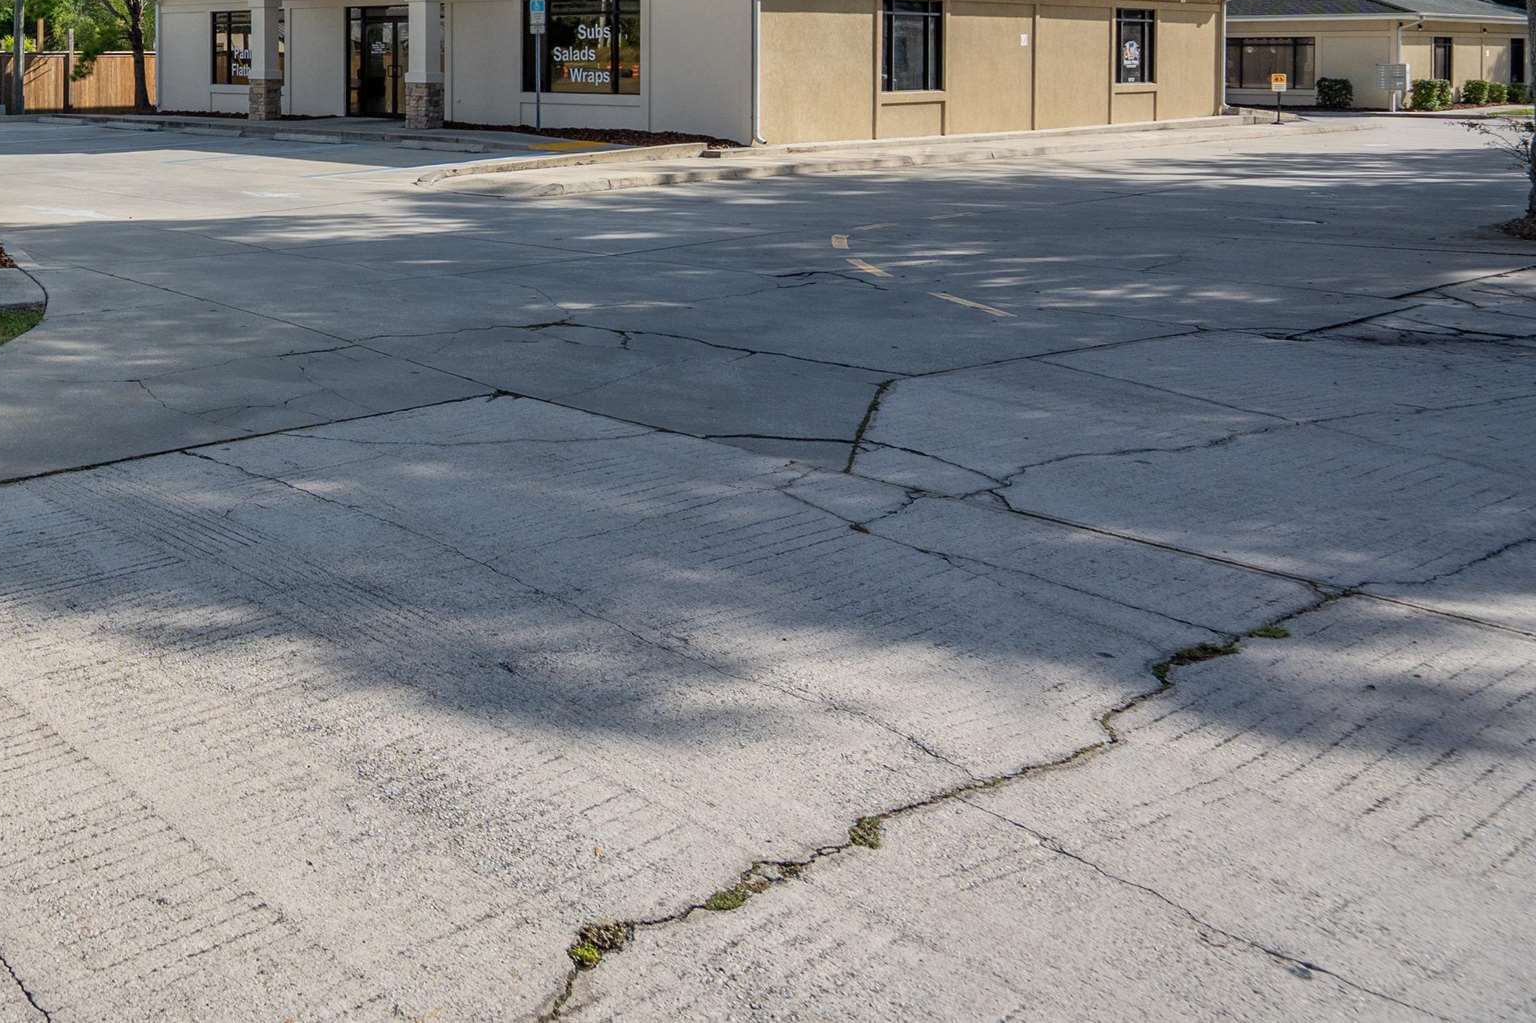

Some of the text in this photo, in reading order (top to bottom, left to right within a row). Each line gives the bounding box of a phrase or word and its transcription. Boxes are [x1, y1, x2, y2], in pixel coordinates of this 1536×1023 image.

[577, 23, 612, 40] Subs
[553, 46, 596, 62] Salads
[569, 67, 611, 86] Wraps
